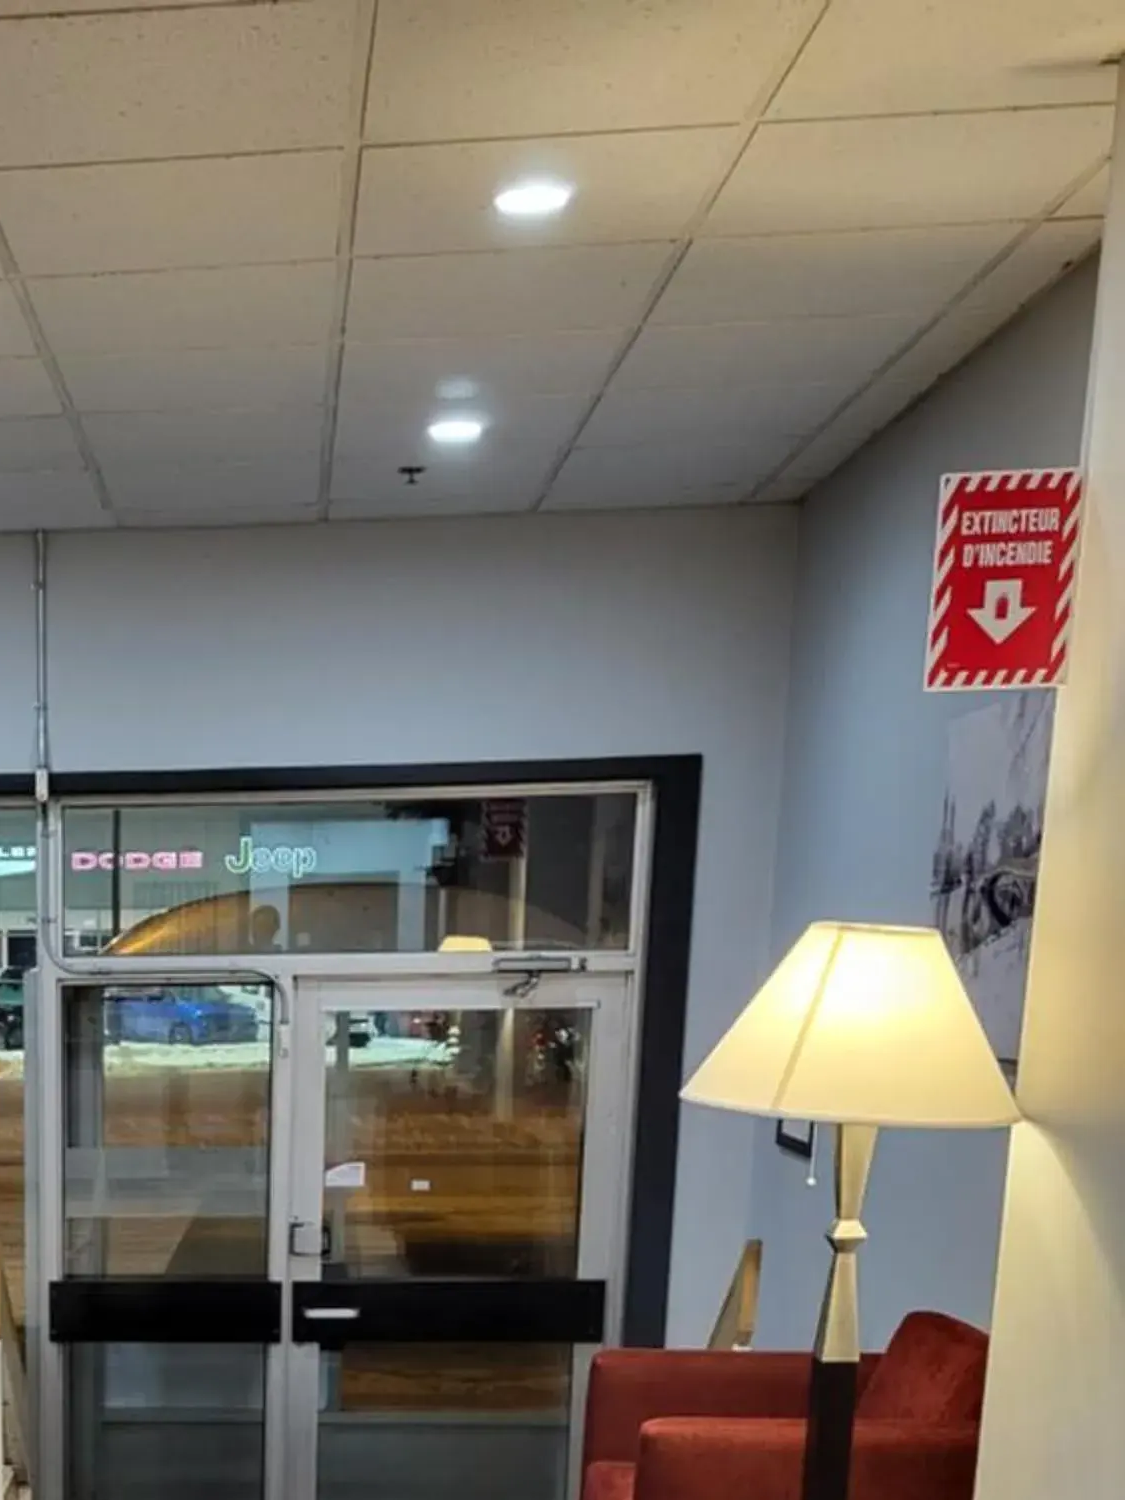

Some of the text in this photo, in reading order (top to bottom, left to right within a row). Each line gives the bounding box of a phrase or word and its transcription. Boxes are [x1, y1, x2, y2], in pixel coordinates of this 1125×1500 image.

[961, 508, 1060, 536] EXTINCTEUR
[962, 540, 1053, 568] D'INCENDIE
[71, 851, 203, 870] DODGE
[225, 836, 317, 878] Jeep
